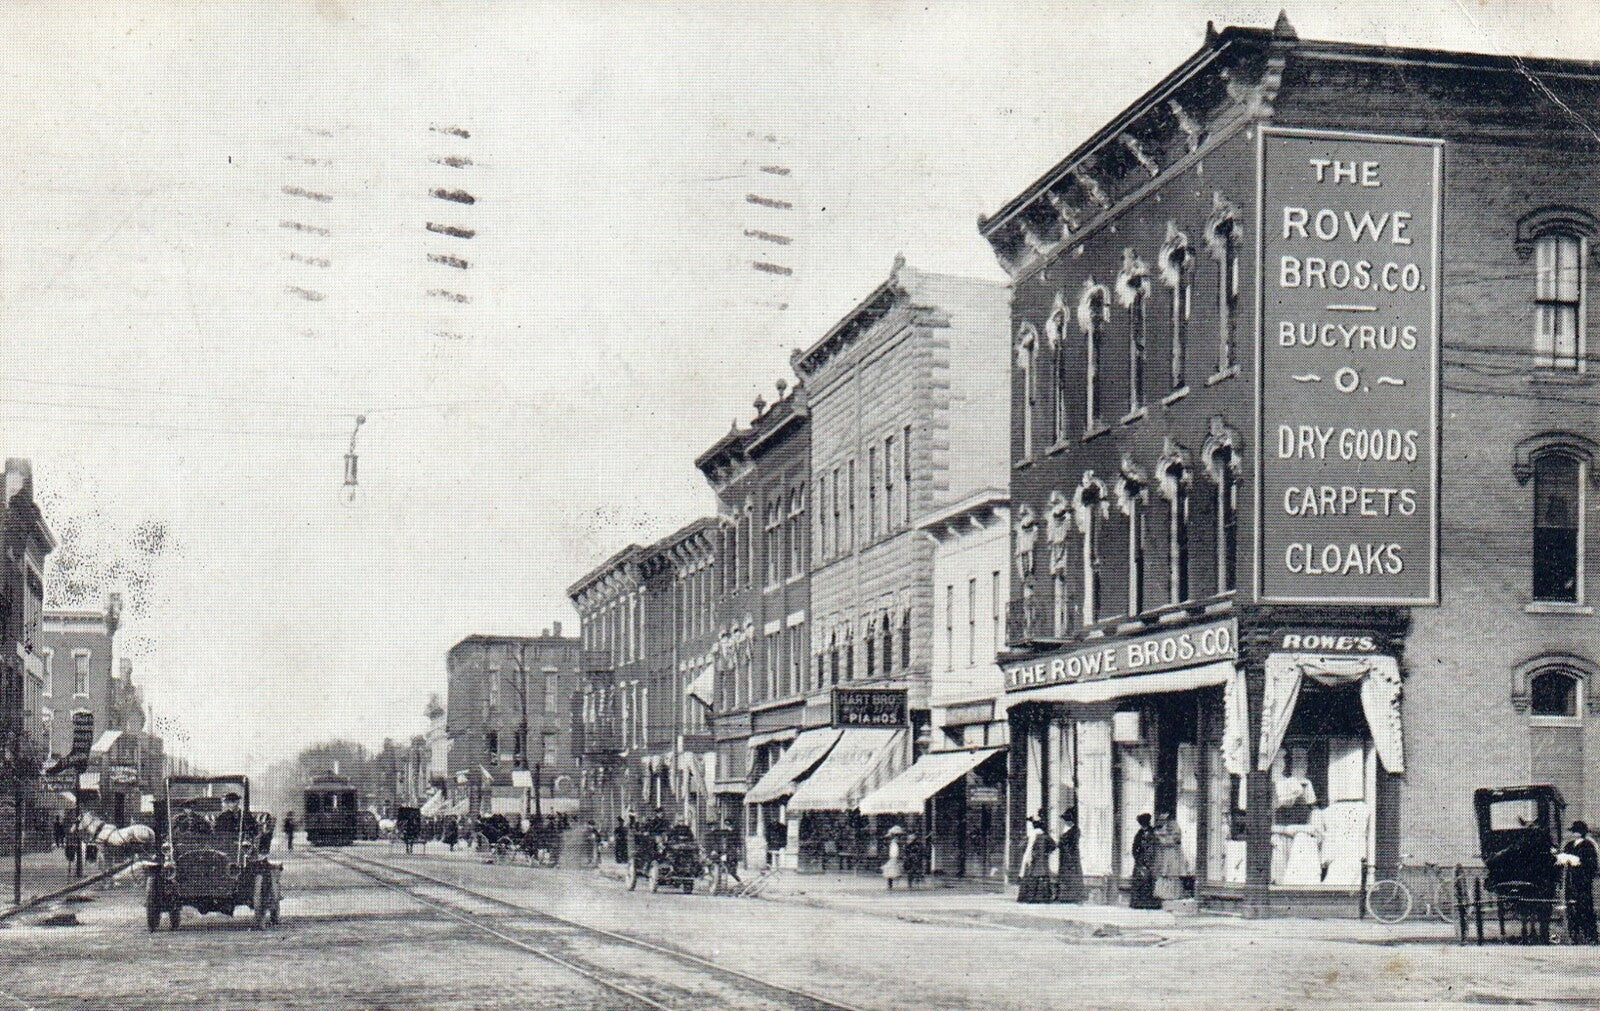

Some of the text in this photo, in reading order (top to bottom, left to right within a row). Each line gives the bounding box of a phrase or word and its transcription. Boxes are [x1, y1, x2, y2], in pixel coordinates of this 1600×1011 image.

[1309, 158, 1381, 188] THE
[1282, 205, 1412, 246] ROWE
[1278, 320, 1418, 351] BUCYRUS
[1333, 366, 1370, 394] O.
[1277, 423, 1419, 462] DRY GOODS
[1282, 485, 1418, 518] CARPETS
[1284, 541, 1404, 575] CLOAKS
[1009, 663, 1047, 685] THE
[1051, 648, 1118, 680] ROWE
